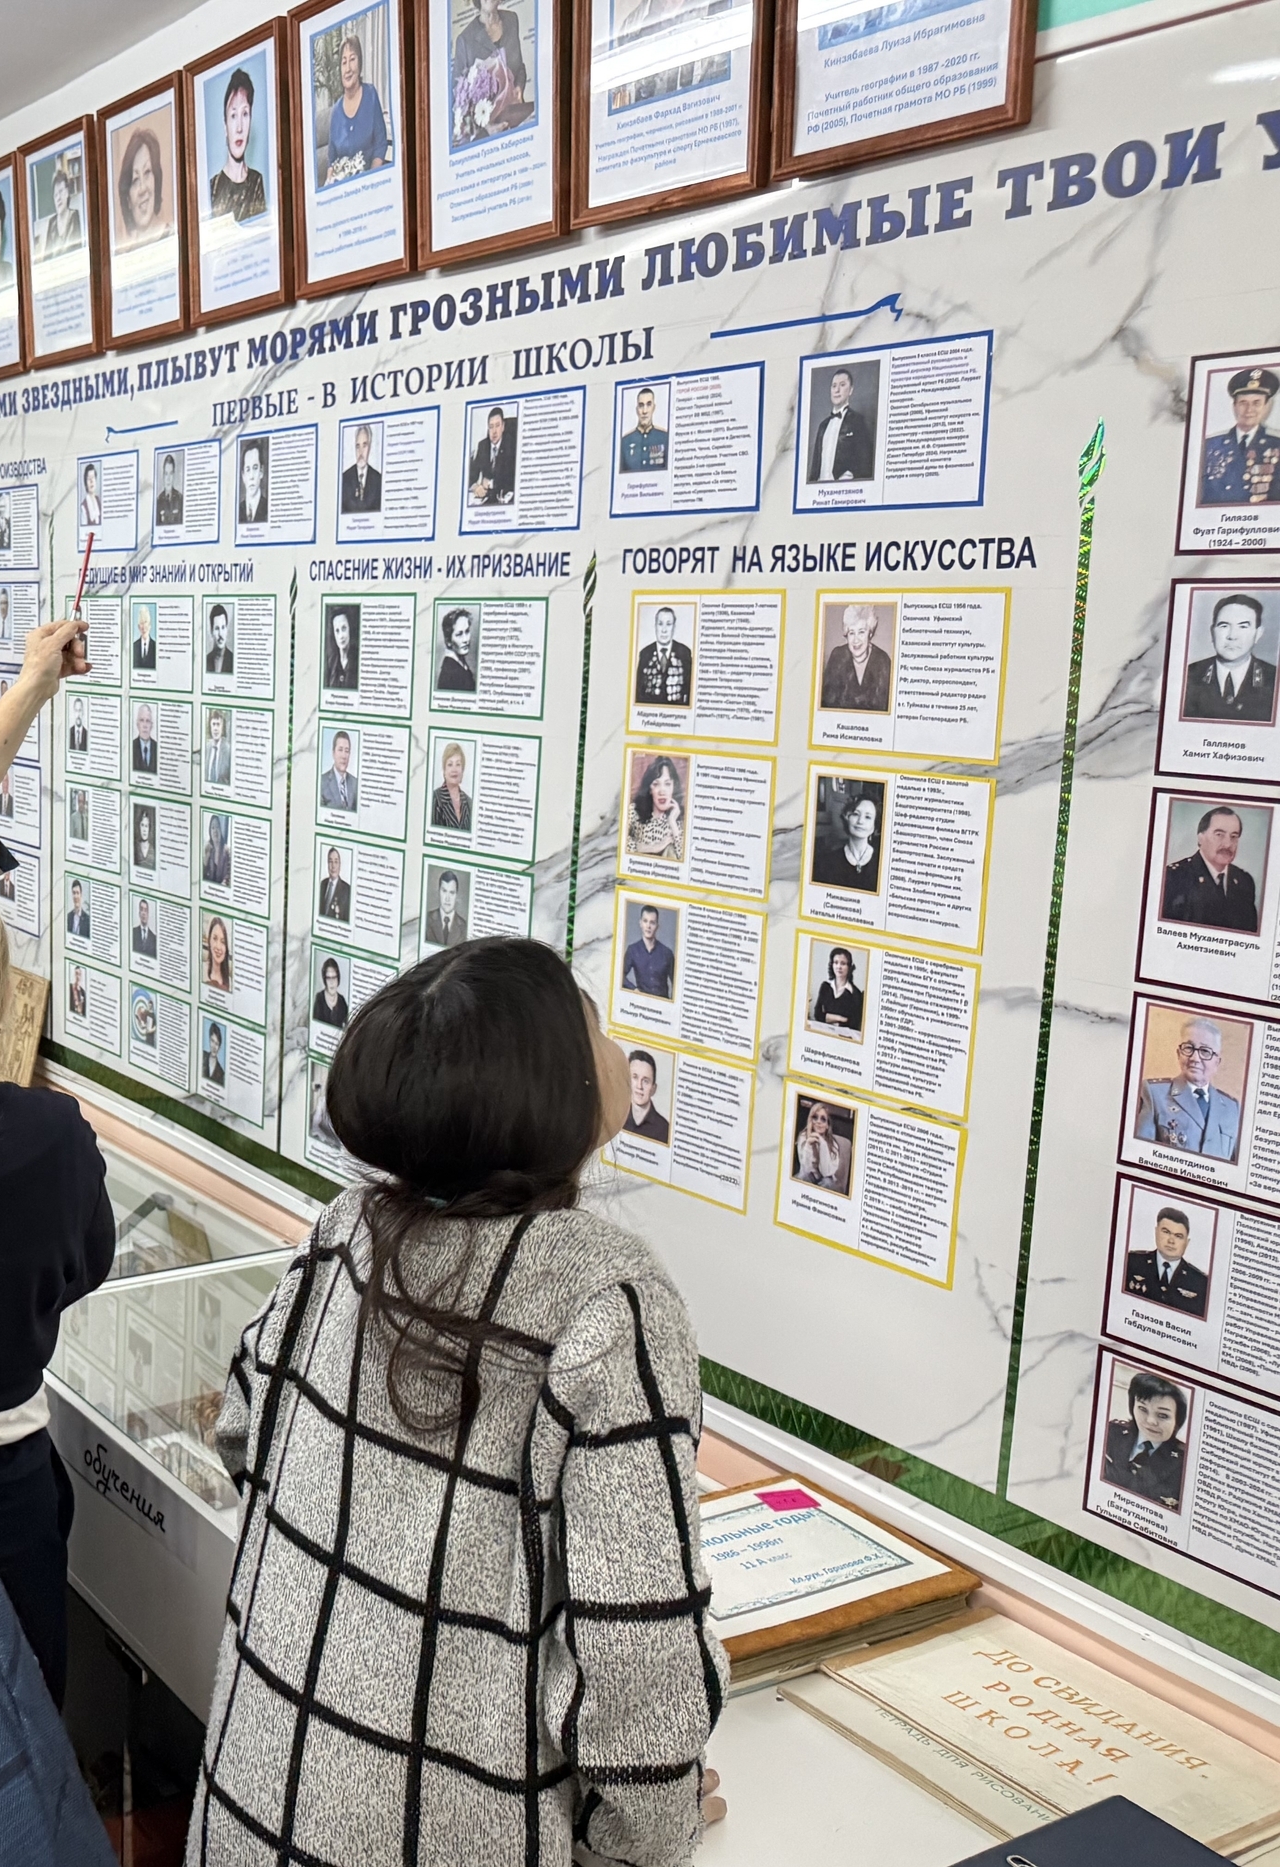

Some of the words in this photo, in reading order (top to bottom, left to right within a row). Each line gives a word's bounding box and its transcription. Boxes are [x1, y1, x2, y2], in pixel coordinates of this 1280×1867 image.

[824, 45, 879, 68] Кинзябаева
[881, 36, 911, 52] Луиза
[913, 13, 985, 41] Ибрагимовна
[808, 101, 851, 121] Почетный
[853, 91, 893, 110] работник
[895, 80, 931, 98] общего
[933, 62, 998, 88] образования
[825, 87, 859, 102] Учитель
[861, 72, 907, 92] географии
[918, 62, 939, 75] 1987
[807, 125, 820, 135] РФ
[850, 105, 893, 123] Почетная
[894, 95, 932, 113] грамота
[935, 90, 951, 102] МО
[953, 85, 966, 98] РБ
[968, 77, 997, 94] (1999)
[137, 341, 239, 391] ПЛЫВУТ
[247, 309, 378, 369] МОРЯМИ
[390, 256, 625, 340] ГРОЗНЫМИ
[641, 176, 973, 290] ЛЮБИМЫЕ
[997, 121, 1226, 220] ТВОИ
[212, 389, 298, 426] ПЕРВЫЕ
[322, 382, 336, 408] В
[350, 355, 489, 404] ИСТОРИИ
[512, 327, 654, 380] ШКОЛЫ
[1193, 528, 1215, 536] Фуат
[1217, 526, 1280, 536] Гарифуллови
[1221, 514, 1259, 522] Гилязов
[622, 546, 719, 575] ГОВОРЯТ
[732, 543, 763, 573] НА
[770, 542, 857, 573] ЯЗЫКЕ
[865, 536, 1037, 571] ИСКУССТВА
[1209, 539, 1232, 548] (1924
[1241, 538, 1266, 547] 2000)
[121, 567, 126, 583] В
[129, 565, 147, 583] МИР
[150, 560, 186, 583] ЗНАНИЙ
[189, 565, 195, 582] И
[198, 558, 253, 582] ОТКРЫТИЙ
[309, 558, 378, 581] СПАСЕНИЕ
[382, 556, 432, 580] ЖИЗНИ
[446, 555, 466, 578] ИХ
[471, 552, 570, 578] ПРИЗВАНИЕ
[837, 723, 869, 731] Кашапова
[840, 734, 882, 742] Исмагиловна
[1182, 750, 1211, 759] Хамит
[1212, 751, 1265, 763] Хафизович
[1203, 738, 1246, 750] Галлямов
[810, 909, 835, 918] Наталья
[836, 914, 874, 926] Николаевна
[1157, 927, 1188, 938] Валеев
[1190, 932, 1260, 950] Мухаматрасуль
[1177, 942, 1236, 958] Ахметзиевич
[1138, 1157, 1178, 1173] Вячеслав
[1180, 1168, 1228, 1187] Ильясович
[1153, 1150, 1215, 1173] Камалетдинов
[1124, 1318, 1197, 1349] Габдулварисович
[1132, 1309, 1164, 1326] Газизов
[1165, 1321, 1191, 1336] Васил
[85, 1444, 165, 1533] обучения
[775, 1511, 816, 1528] годы
[1107, 1500, 1168, 1533] (Багаутдинова)
[1114, 1492, 1163, 1519] Мирсаитова
[1096, 1505, 1132, 1526] Гульнара
[1133, 1522, 1178, 1546] Сабитовна
[982, 1681, 1133, 1764] РОДНАЯ
[874, 1706, 931, 1746] ТЕТРАДЬ
[933, 1748, 970, 1769] ДЛЯ
